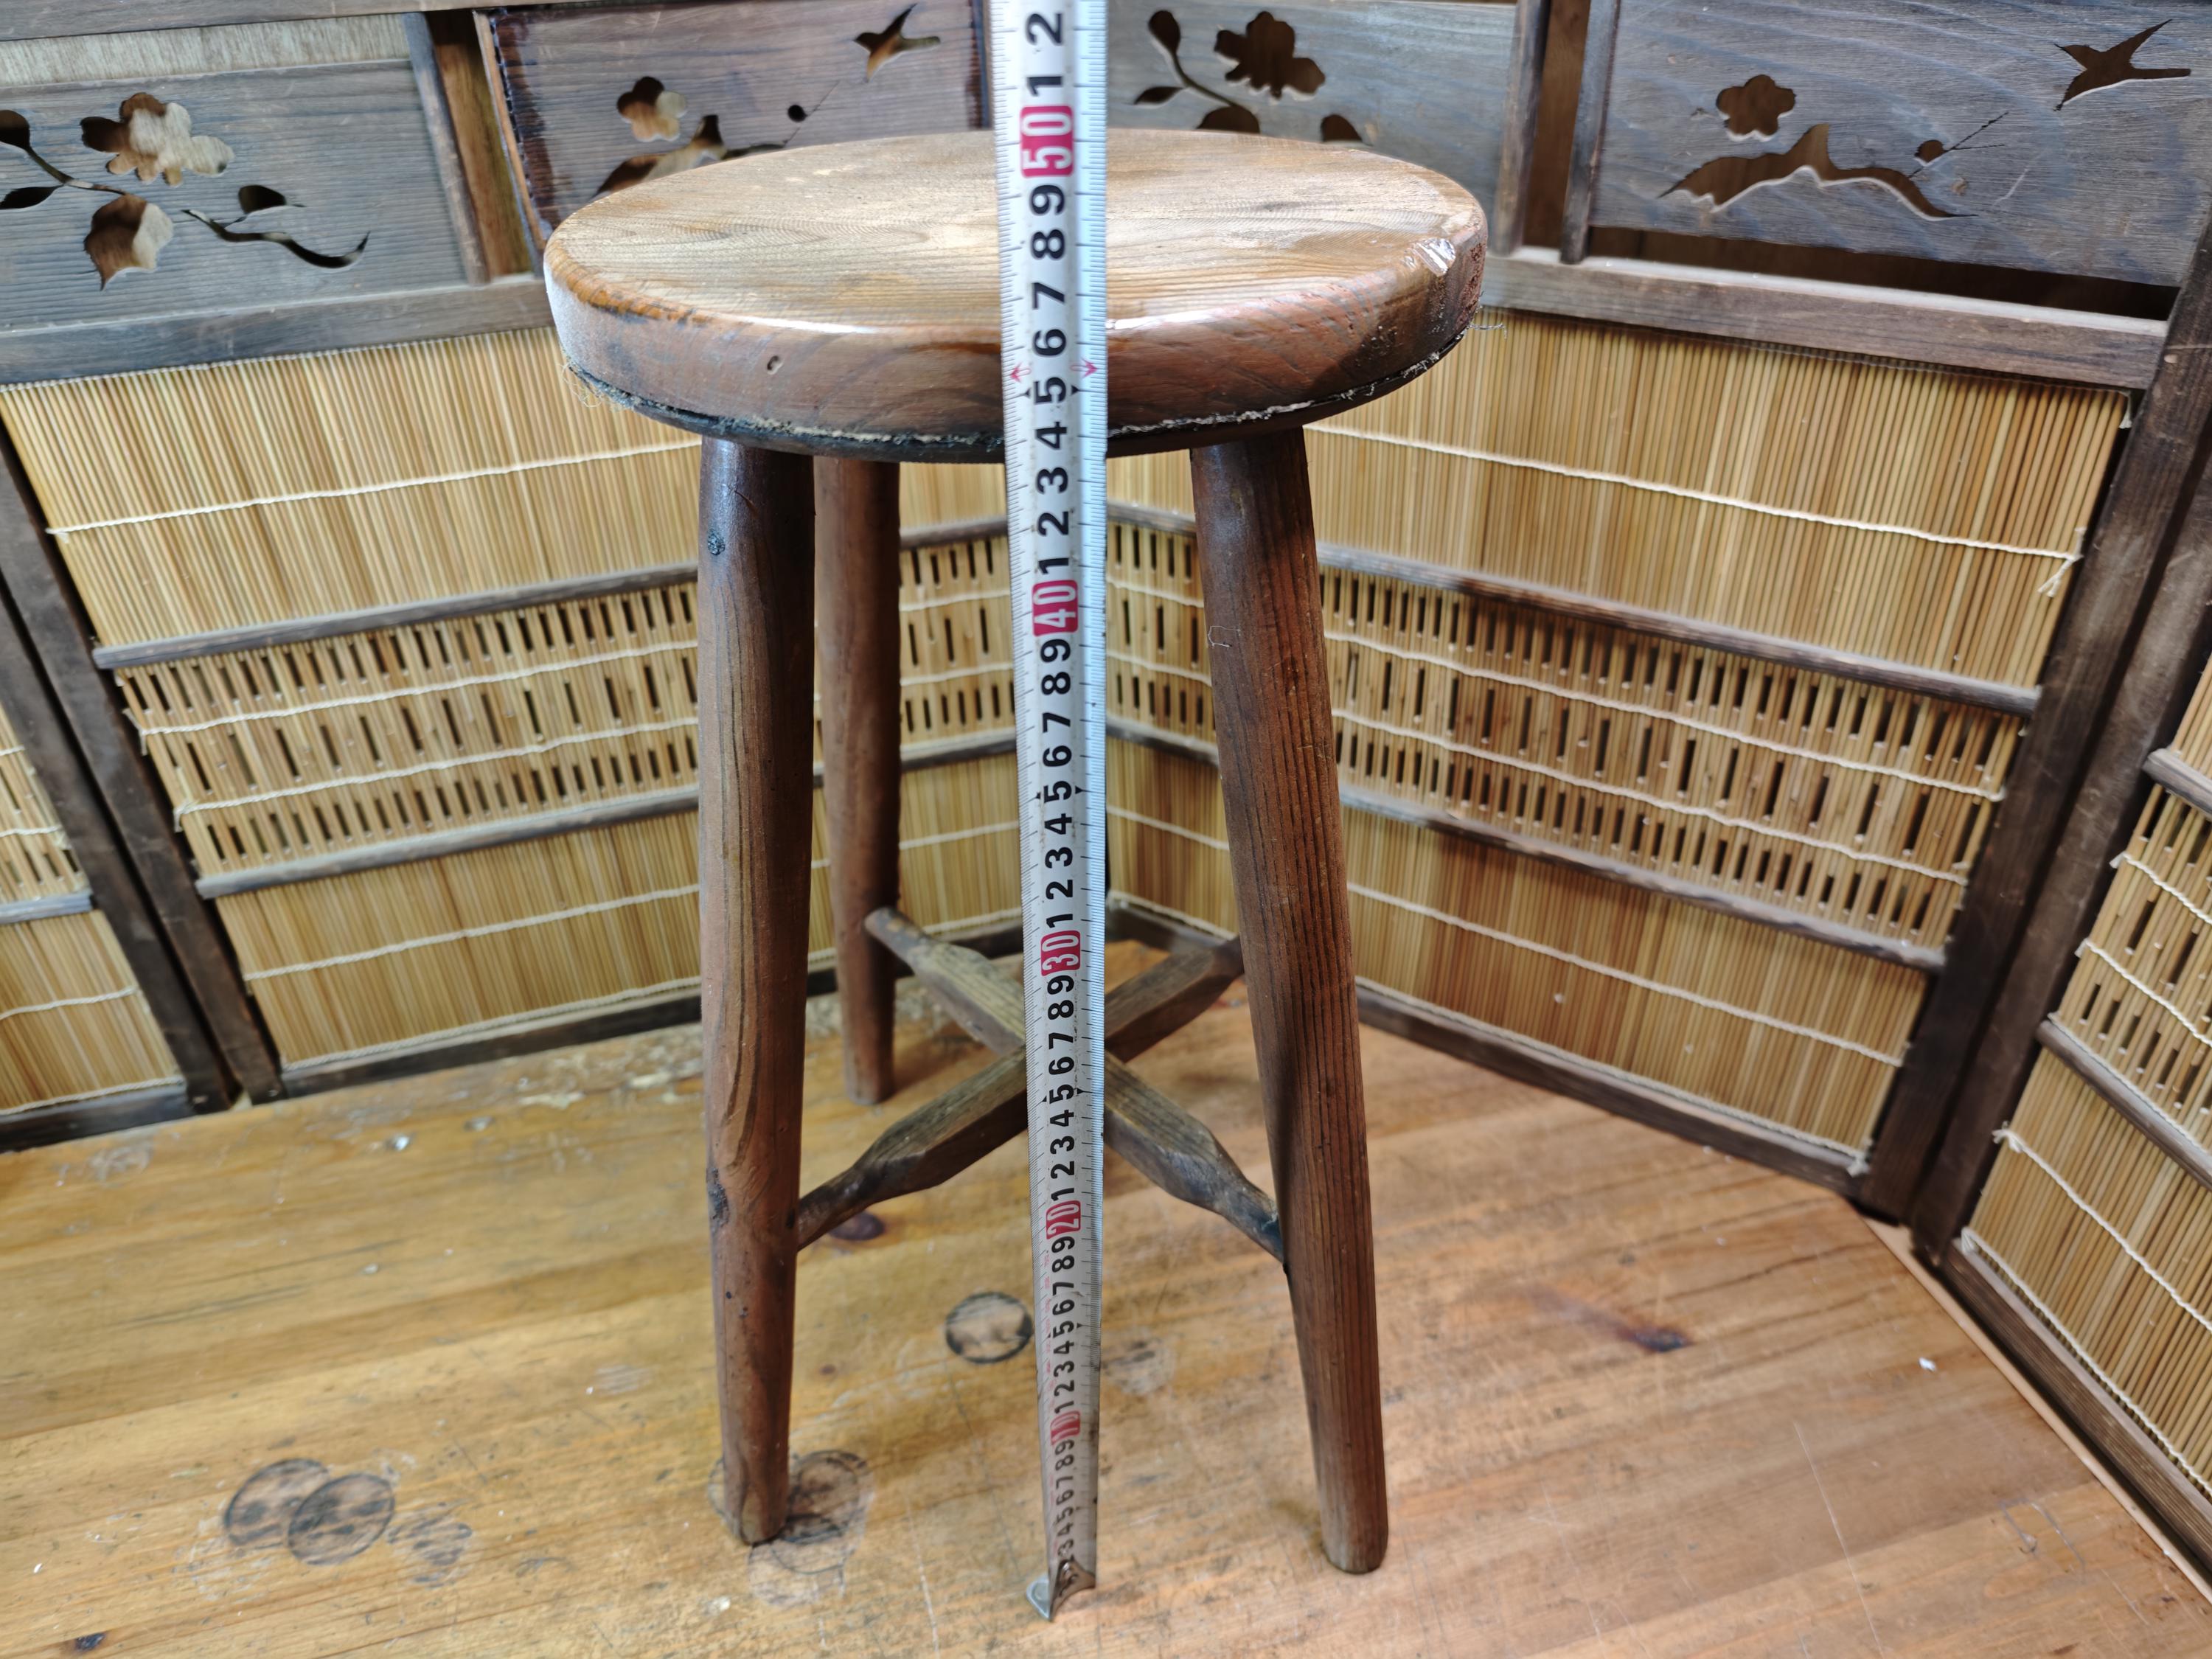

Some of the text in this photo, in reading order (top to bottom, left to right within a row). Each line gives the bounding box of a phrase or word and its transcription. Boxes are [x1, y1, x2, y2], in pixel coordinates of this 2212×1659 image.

[1025, 13, 1064, 46] 2
[1026, 75, 1064, 97] 1
[1020, 113, 1072, 170] 50
[1029, 185, 1065, 216] 9
[1030, 229, 1065, 260] 8
[1032, 282, 1065, 310] 7
[1033, 329, 1067, 357] 6
[1034, 377, 1067, 405] 5
[1035, 421, 1068, 450] 4
[1035, 467, 1068, 495] 3
[1037, 511, 1069, 537] 2
[1038, 557, 1069, 575] 1
[1033, 585, 1077, 628] 40
[1040, 639, 1071, 663] 9
[1041, 672, 1071, 695] 8
[1042, 712, 1071, 734] 7
[1043, 745, 1072, 767] 6
[1043, 781, 1072, 804] 5
[1044, 813, 1073, 835] 4
[1045, 847, 1074, 869] 3
[1046, 879, 1074, 900] 2
[1046, 914, 1074, 928] 1
[1042, 934, 1079, 971] 30
[1047, 975, 1074, 995] 9
[1048, 1000, 1074, 1020] 8
[1048, 1032, 1074, 1049] 7
[1048, 1057, 1075, 1075] 6
[1049, 1085, 1074, 1104] 5
[1050, 1110, 1074, 1127] 4
[1050, 1136, 1075, 1155] 3
[1051, 1161, 1075, 1179] 2
[1051, 1188, 1074, 1201] 1
[1047, 1203, 1079, 1235] 20
[1051, 1237, 1075, 1253] 9
[1052, 1256, 1075, 1273] 8
[1052, 1281, 1074, 1295] 7
[1052, 1299, 1075, 1315] 6
[1053, 1321, 1074, 1338] 5
[1053, 1340, 1074, 1354] 4
[1054, 1361, 1074, 1377] 3
[1054, 1380, 1074, 1397] 2
[1054, 1401, 1074, 1413] 1
[1055, 1439, 1074, 1455] 9
[1055, 1455, 1074, 1471] 8
[1056, 1476, 1074, 1489] 7
[1056, 1489, 1074, 1506] 6
[1056, 1507, 1074, 1525] 5
[1057, 1523, 1074, 1537] 4
